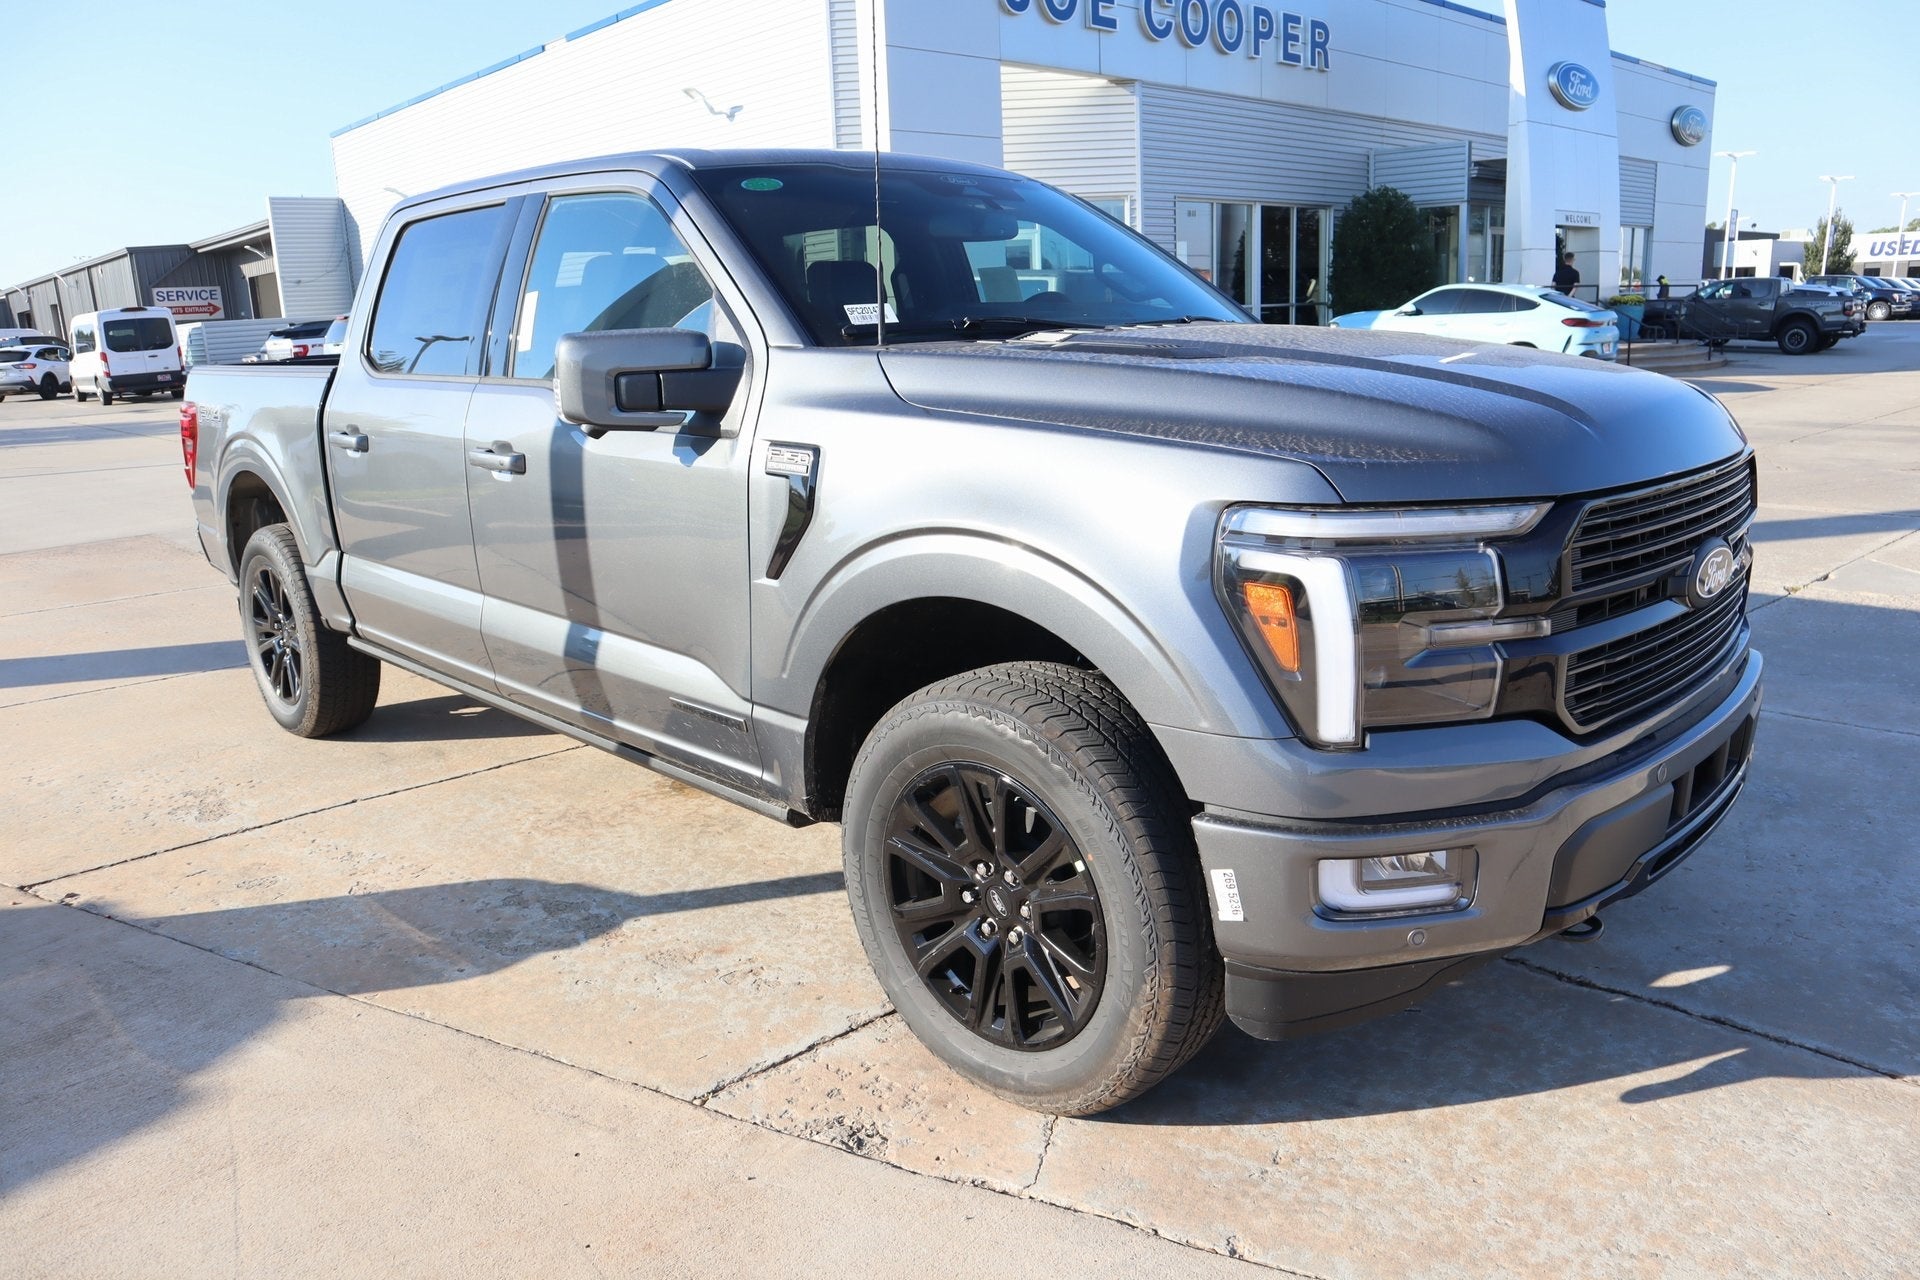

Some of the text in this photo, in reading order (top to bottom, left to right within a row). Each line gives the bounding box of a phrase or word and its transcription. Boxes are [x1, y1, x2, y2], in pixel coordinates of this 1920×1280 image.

[1142, 0, 1331, 71] COOPER
[1568, 70, 1594, 99] Ford
[1686, 113, 1705, 138] Ford
[1564, 214, 1592, 225] WELCOME
[156, 289, 218, 302] SERVICE
[1704, 554, 1729, 592] Ford
[1222, 872, 1236, 890] 269
